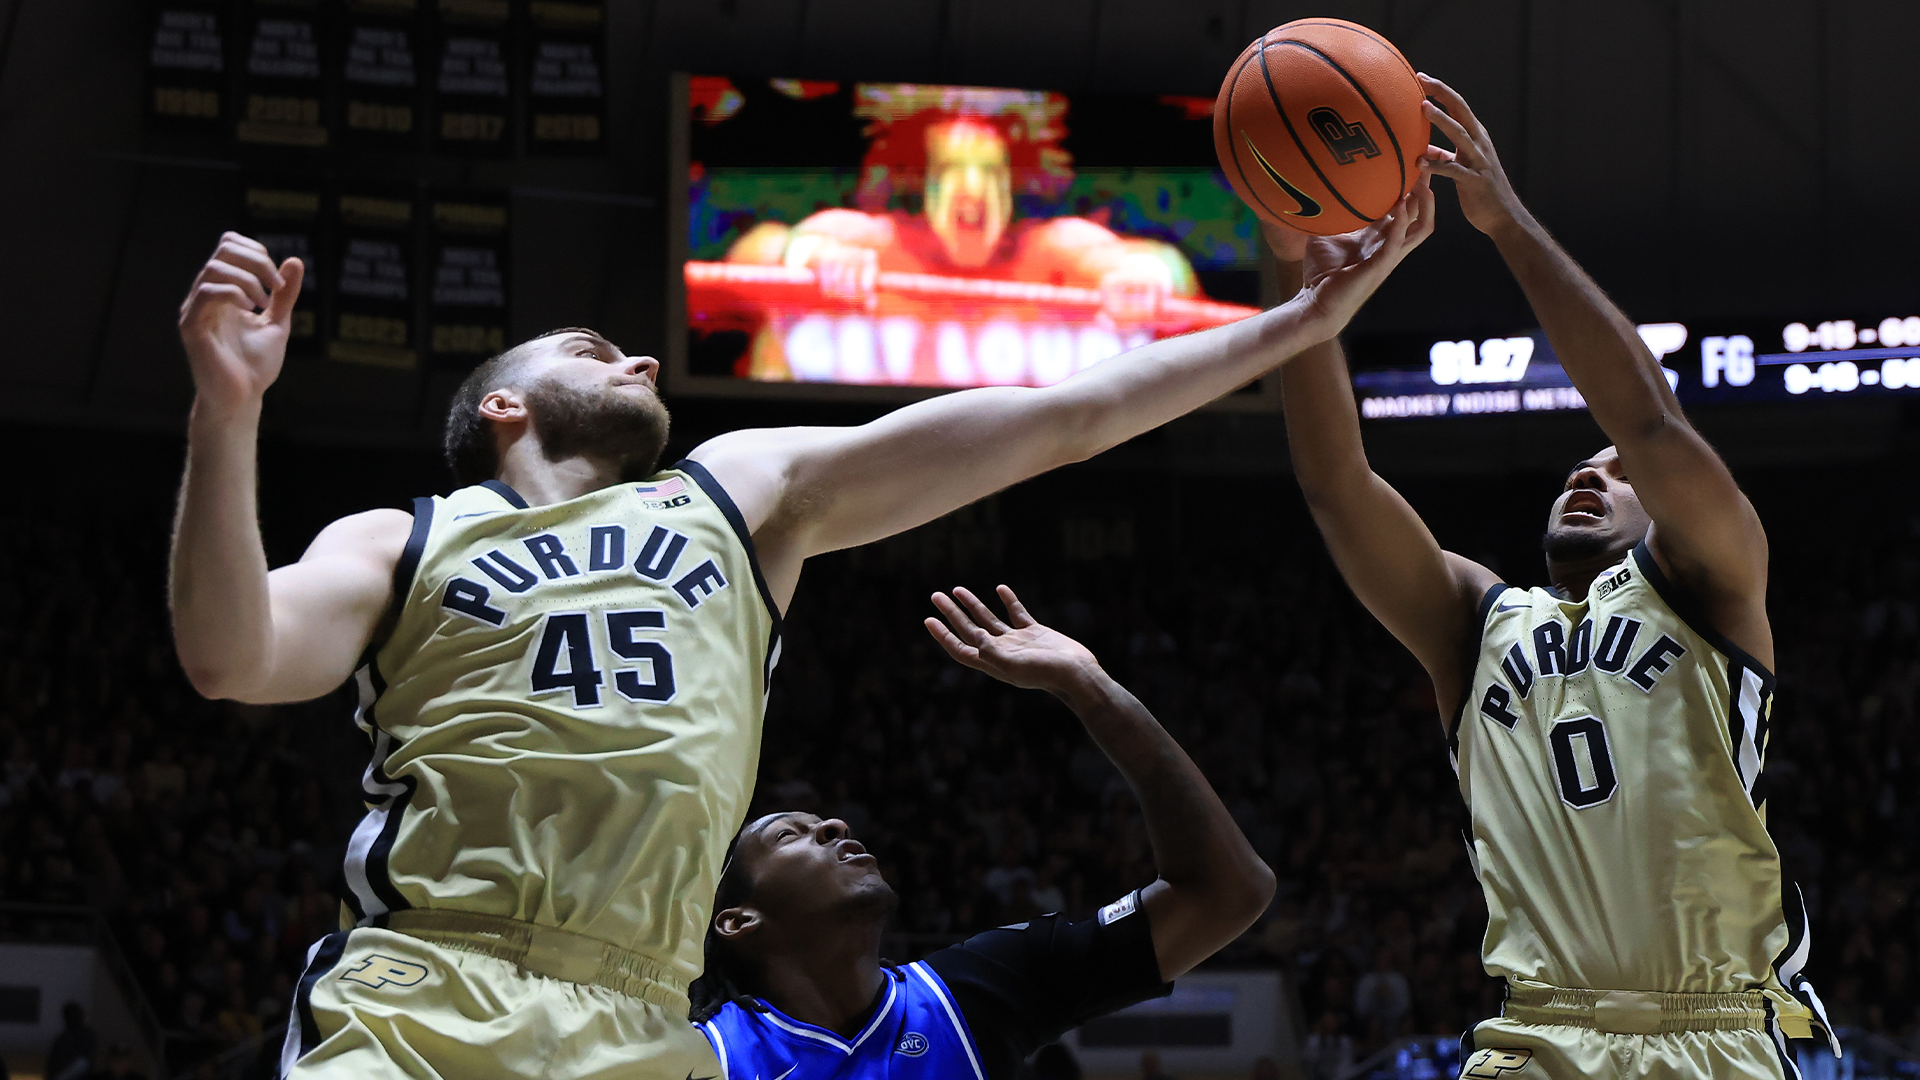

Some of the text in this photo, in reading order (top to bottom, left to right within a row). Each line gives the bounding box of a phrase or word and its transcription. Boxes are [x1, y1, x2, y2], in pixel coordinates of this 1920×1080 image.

[441, 113, 504, 139] 2017
[937, 318, 1152, 386] LOUD
[1701, 335, 1755, 387] FG
[1362, 394, 1450, 418] MACKEY
[1453, 390, 1520, 413] NOISE
[441, 523, 730, 629] PURDUE
[531, 607, 677, 710] 45
[1480, 614, 1688, 733] PURDUE
[1547, 714, 1620, 811] 0
[338, 953, 429, 990] P
[901, 1038, 921, 1050] OVC
